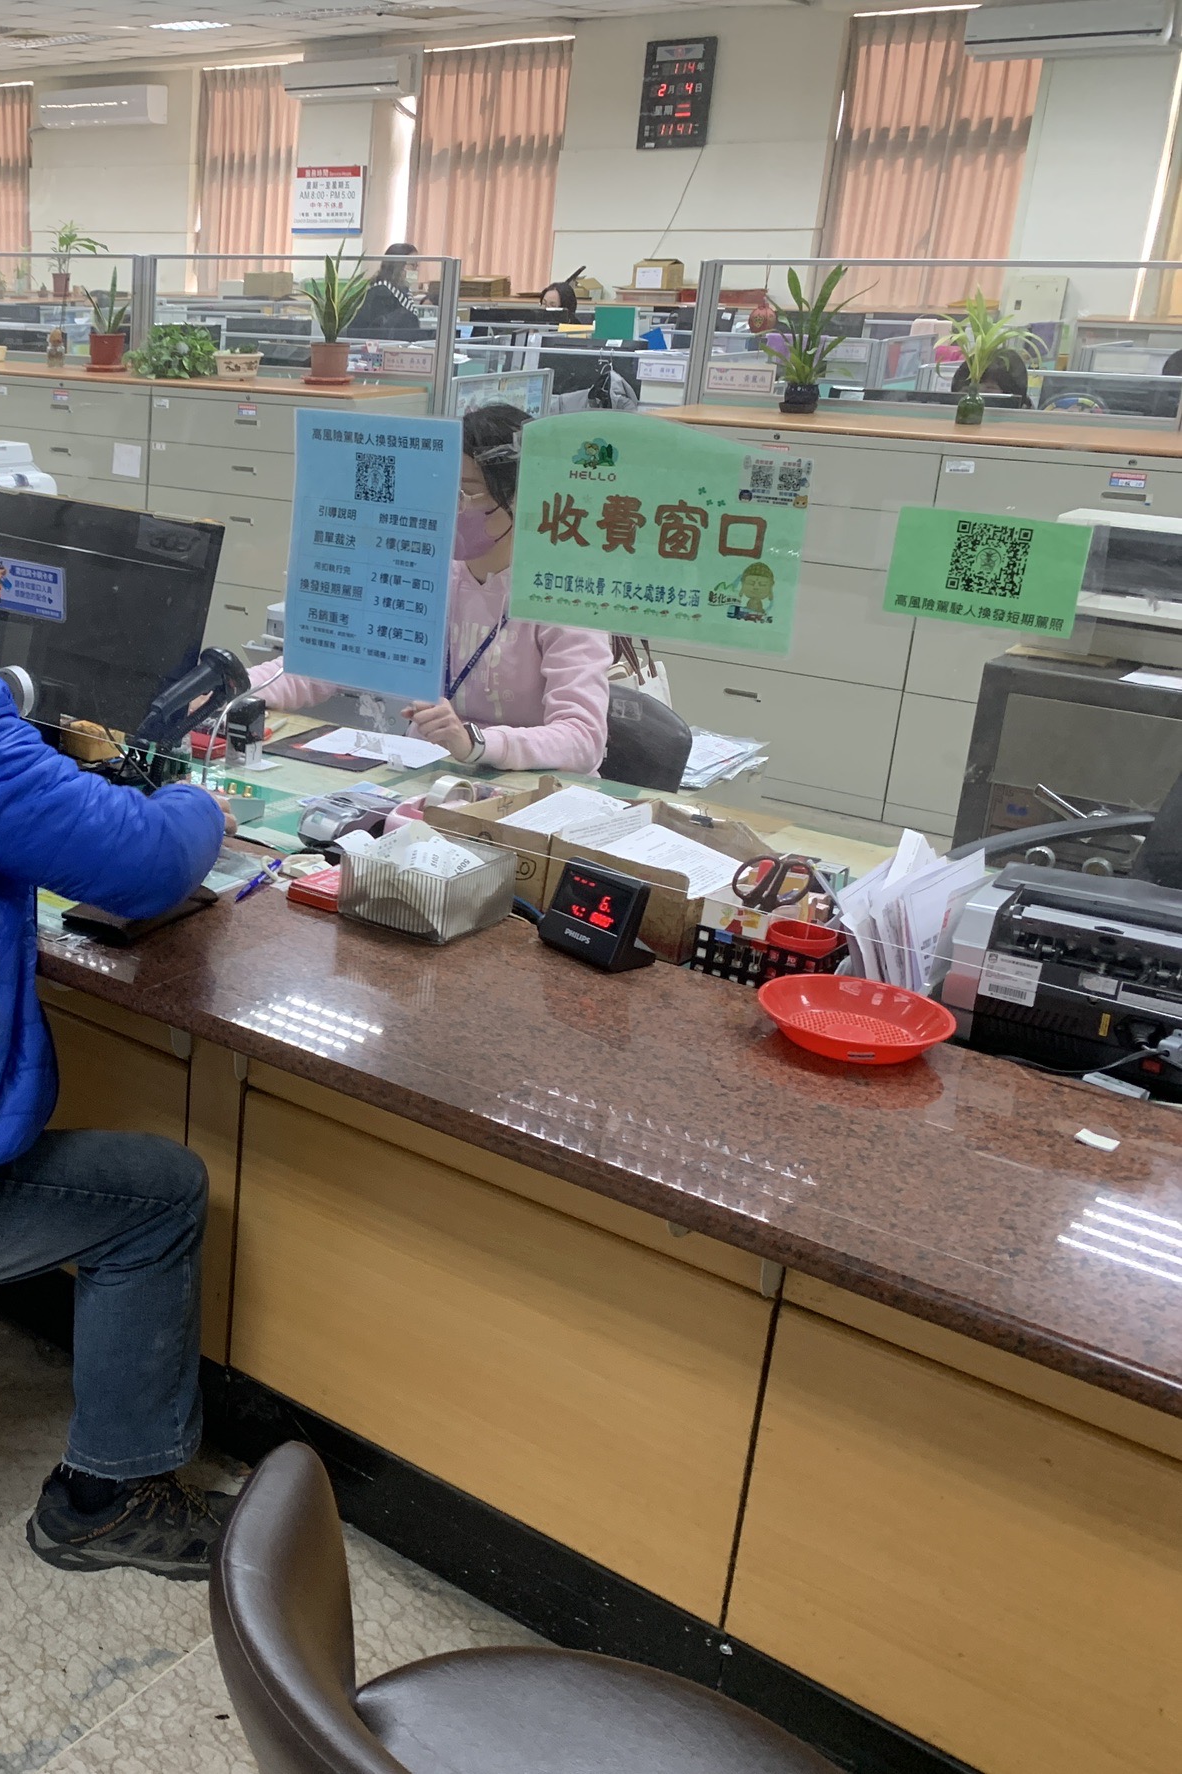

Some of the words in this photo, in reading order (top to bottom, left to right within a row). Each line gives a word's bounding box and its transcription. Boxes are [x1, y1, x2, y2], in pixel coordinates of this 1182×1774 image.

[312, 428, 444, 452] 高風險駕駛人換發短期駕照
[569, 470, 617, 482] HELLO
[318, 505, 357, 521] 引導說明
[379, 512, 438, 531] 辦理位置提醒
[537, 492, 768, 561] 收費窗口
[300, 578, 363, 599] 換發短期駕照
[533, 571, 606, 597] 本窗口僅供收費
[611, 580, 701, 607] 不便之處請多包涵
[307, 607, 349, 626] 吊銷重考
[895, 594, 1065, 632] 高風險駕駛人換發短期駕照
[564, 927, 591, 945] PHILIPS
